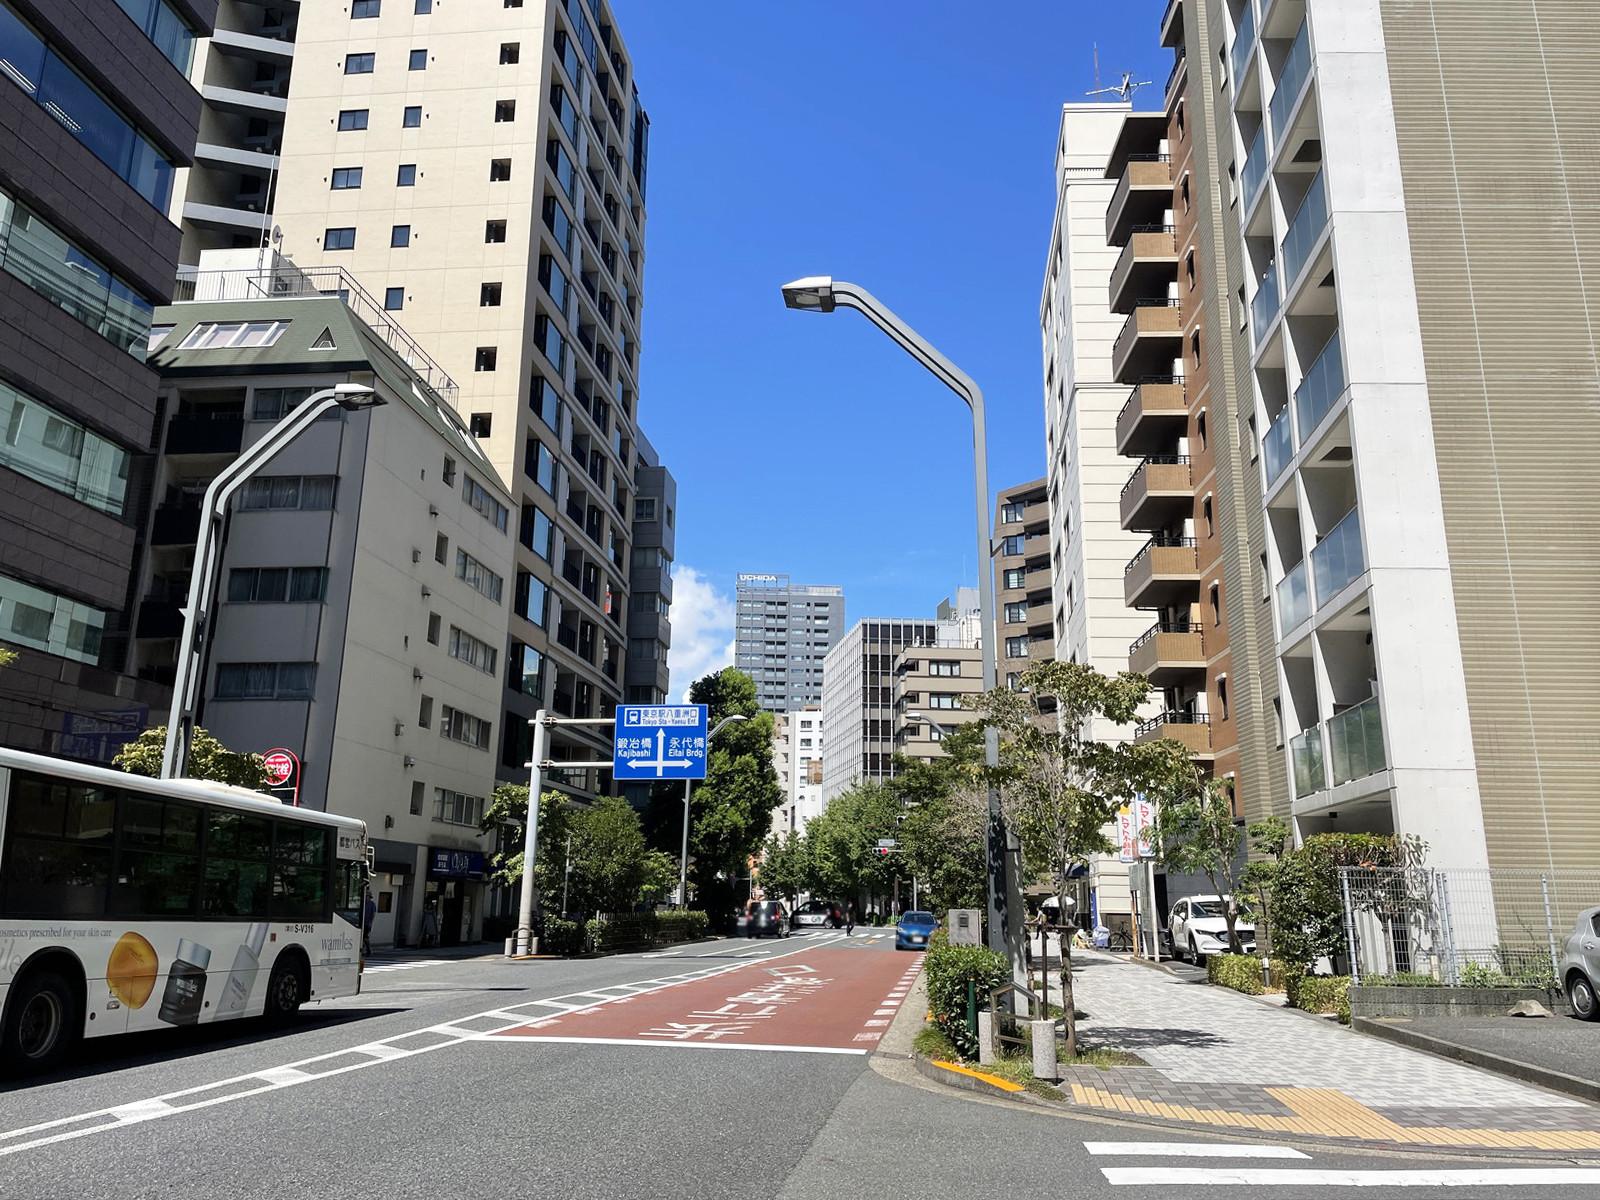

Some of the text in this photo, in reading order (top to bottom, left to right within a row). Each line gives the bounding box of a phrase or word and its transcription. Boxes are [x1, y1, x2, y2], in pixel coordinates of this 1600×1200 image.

[642, 709, 697, 718] 東京駅八重洲口
[669, 737, 705, 749] 永代橋
[617, 749, 651, 758] Kajibashi
[668, 748, 705, 758] Eitai Brdg.
[29, 927, 62, 940] prescribed
[62, 927, 72, 937] for
[73, 929, 87, 939] your
[87, 928, 99, 937] skin
[100, 929, 112, 937] care
[294, 924, 314, 933] S-V316
[321, 932, 353, 951] wamiles
